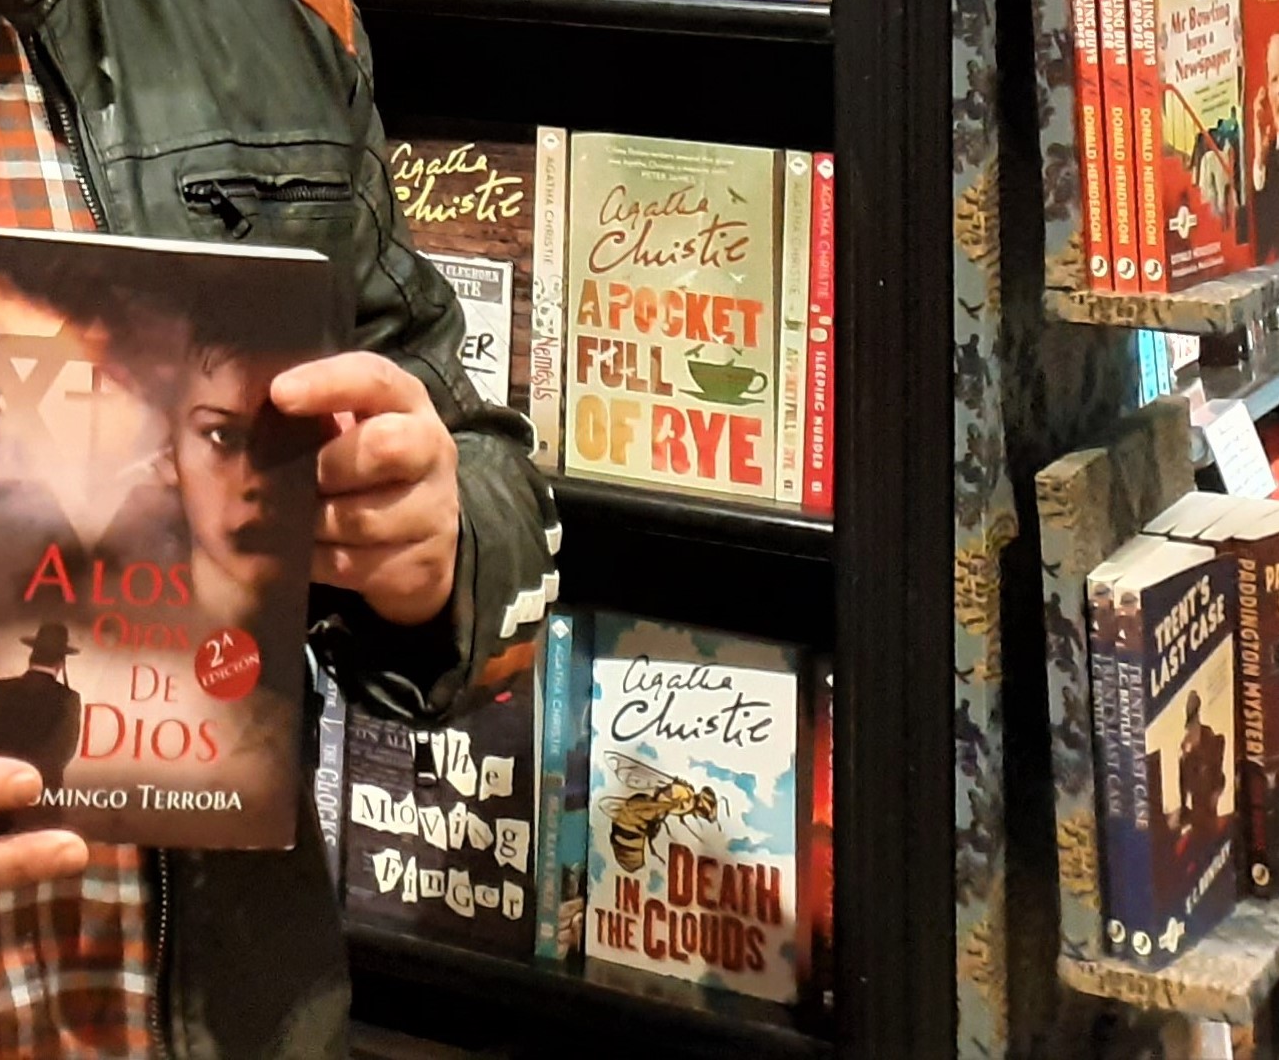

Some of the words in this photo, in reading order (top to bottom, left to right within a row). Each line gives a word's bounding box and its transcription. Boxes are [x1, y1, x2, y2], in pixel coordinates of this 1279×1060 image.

[1172, 11, 1188, 35] Mr
[1188, 0, 1232, 31] Bowling
[1175, 47, 1233, 84] Newspaper
[1083, 105, 1097, 160] DONALD
[1111, 107, 1126, 161] DONALD
[1139, 108, 1154, 162] DONALD
[390, 142, 488, 188] Agatha
[545, 155, 556, 208] AGATHA
[600, 184, 709, 231] Agatha
[820, 184, 831, 236] AGATHA
[1086, 163, 1103, 243] HENDERSON
[1114, 165, 1130, 245] HENDERSON
[1142, 166, 1158, 246] HENDERSON
[543, 210, 555, 265] CHRISTIE
[588, 213, 750, 274] Christie
[819, 240, 831, 299] CHRISTIE
[577, 278, 603, 329] A
[608, 283, 764, 349] POCKET
[575, 335, 674, 397] FULL
[814, 351, 827, 411] SLEEPING
[574, 393, 643, 467] OF
[650, 403, 764, 487] RYE
[812, 415, 825, 469] MURDER
[23, 542, 77, 605] A
[91, 559, 192, 607] LOS
[1153, 574, 1211, 655] TRENT'S
[1237, 557, 1260, 678] PADDINGTON
[1149, 636, 1187, 698] LAST
[1189, 593, 1226, 652] CASE
[129, 663, 180, 704] DE
[623, 655, 734, 700] Agatha
[79, 702, 220, 765] DIOS
[551, 698, 562, 755] CHRISTIE
[610, 692, 774, 748] Christie
[1243, 681, 1266, 768] MYSTERY
[324, 744, 338, 766] THE
[29, 787, 128, 809] MINGO
[136, 784, 242, 811] TERROBA
[316, 768, 339, 847] CLOCKS
[615, 875, 641, 916] IN
[667, 842, 782, 925] DEATH
[594, 907, 638, 951] THE
[642, 898, 767, 973] CLOUDS
